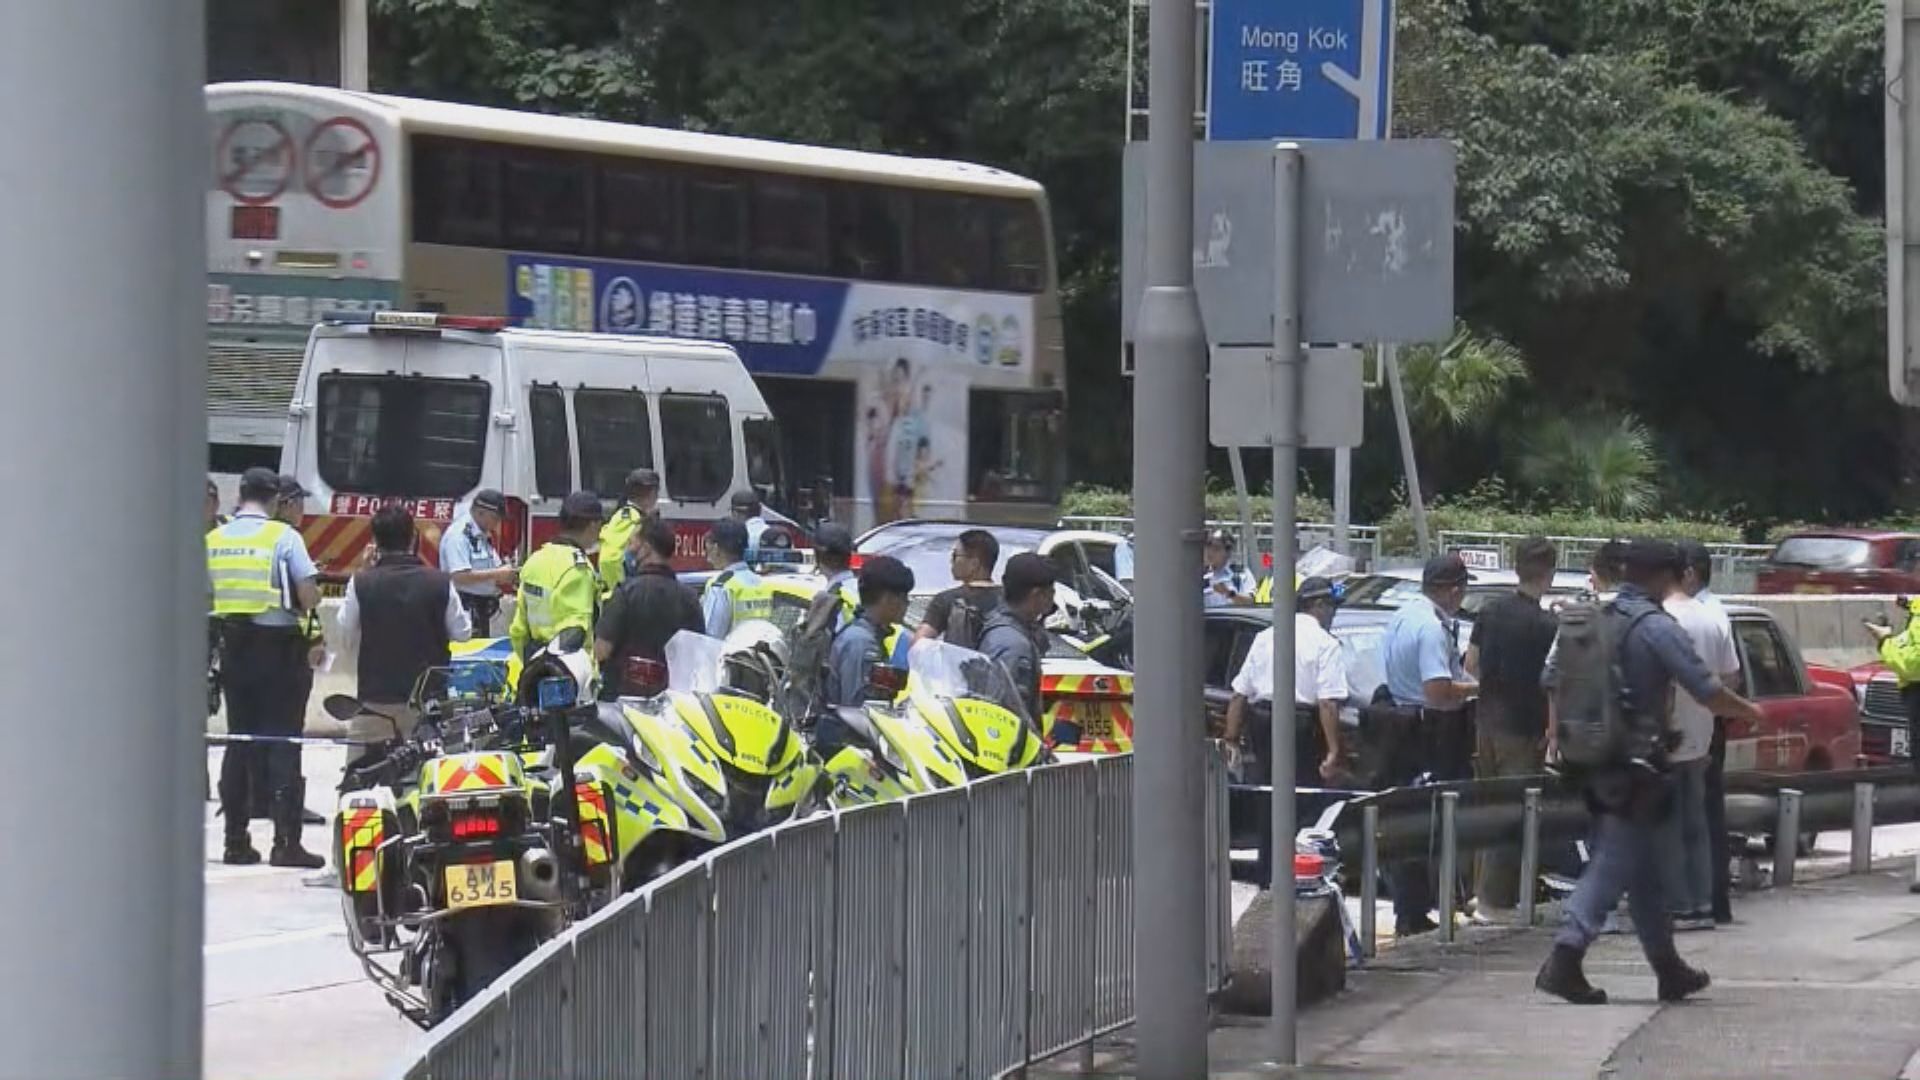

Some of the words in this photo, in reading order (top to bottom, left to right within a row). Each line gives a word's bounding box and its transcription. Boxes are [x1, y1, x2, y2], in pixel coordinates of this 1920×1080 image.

[1241, 26, 1299, 53] Mong
[1308, 27, 1348, 49] Kok
[1242, 60, 1302, 91] 旺角
[356, 496, 428, 518] POCE
[467, 867, 496, 889] AM
[451, 880, 513, 903] 6345
